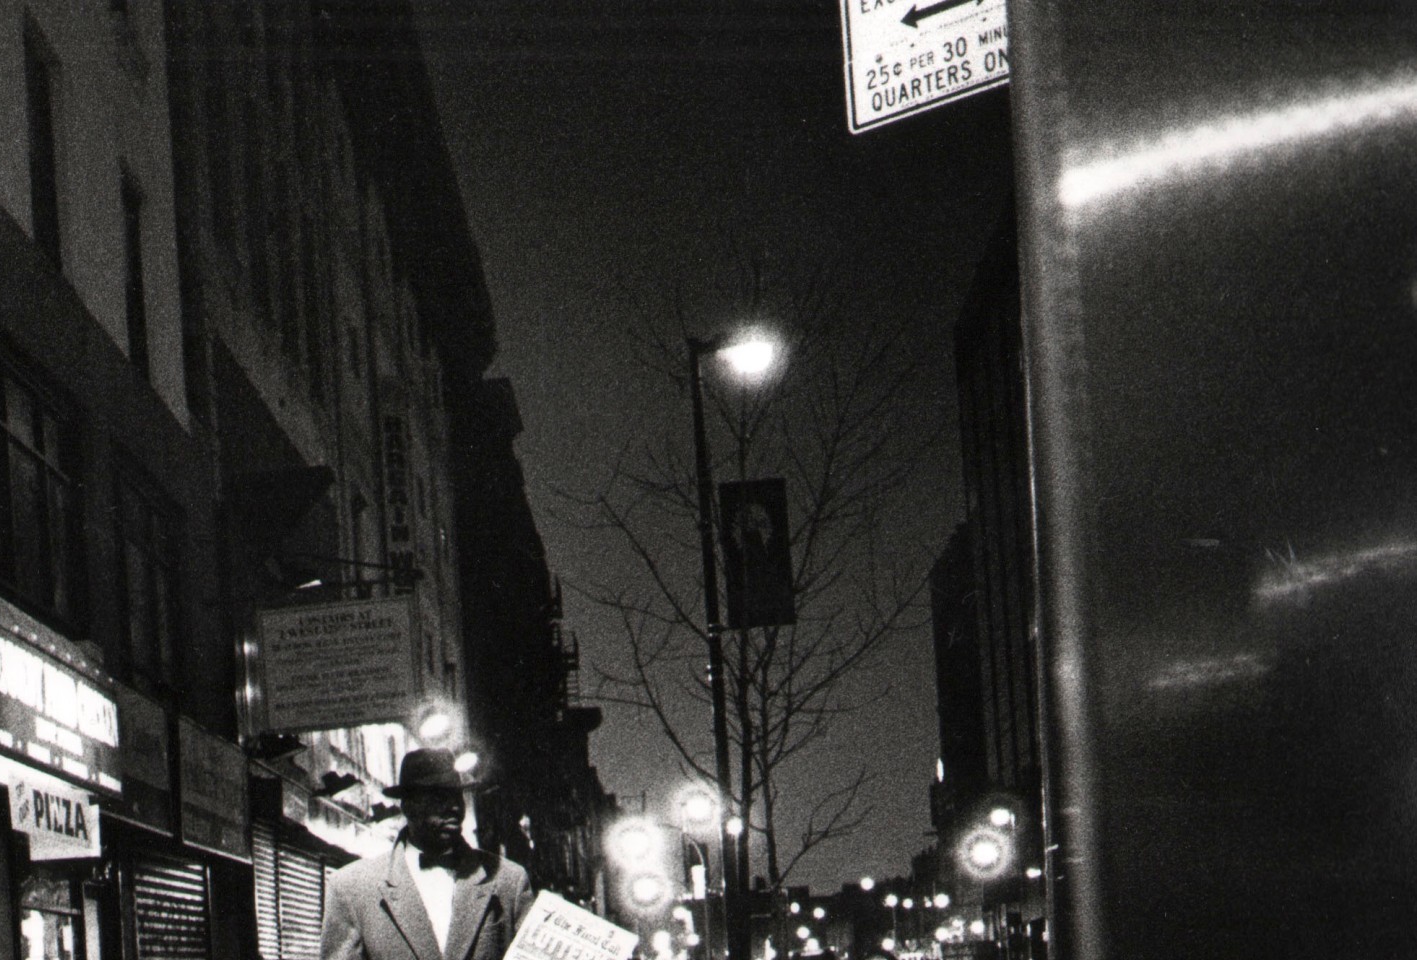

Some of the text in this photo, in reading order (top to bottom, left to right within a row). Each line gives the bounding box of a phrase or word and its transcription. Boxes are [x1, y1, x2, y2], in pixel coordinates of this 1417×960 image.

[866, 62, 903, 90] 25¢
[909, 51, 935, 70] PER
[942, 36, 967, 62] 30
[871, 60, 972, 112] QUARTERS
